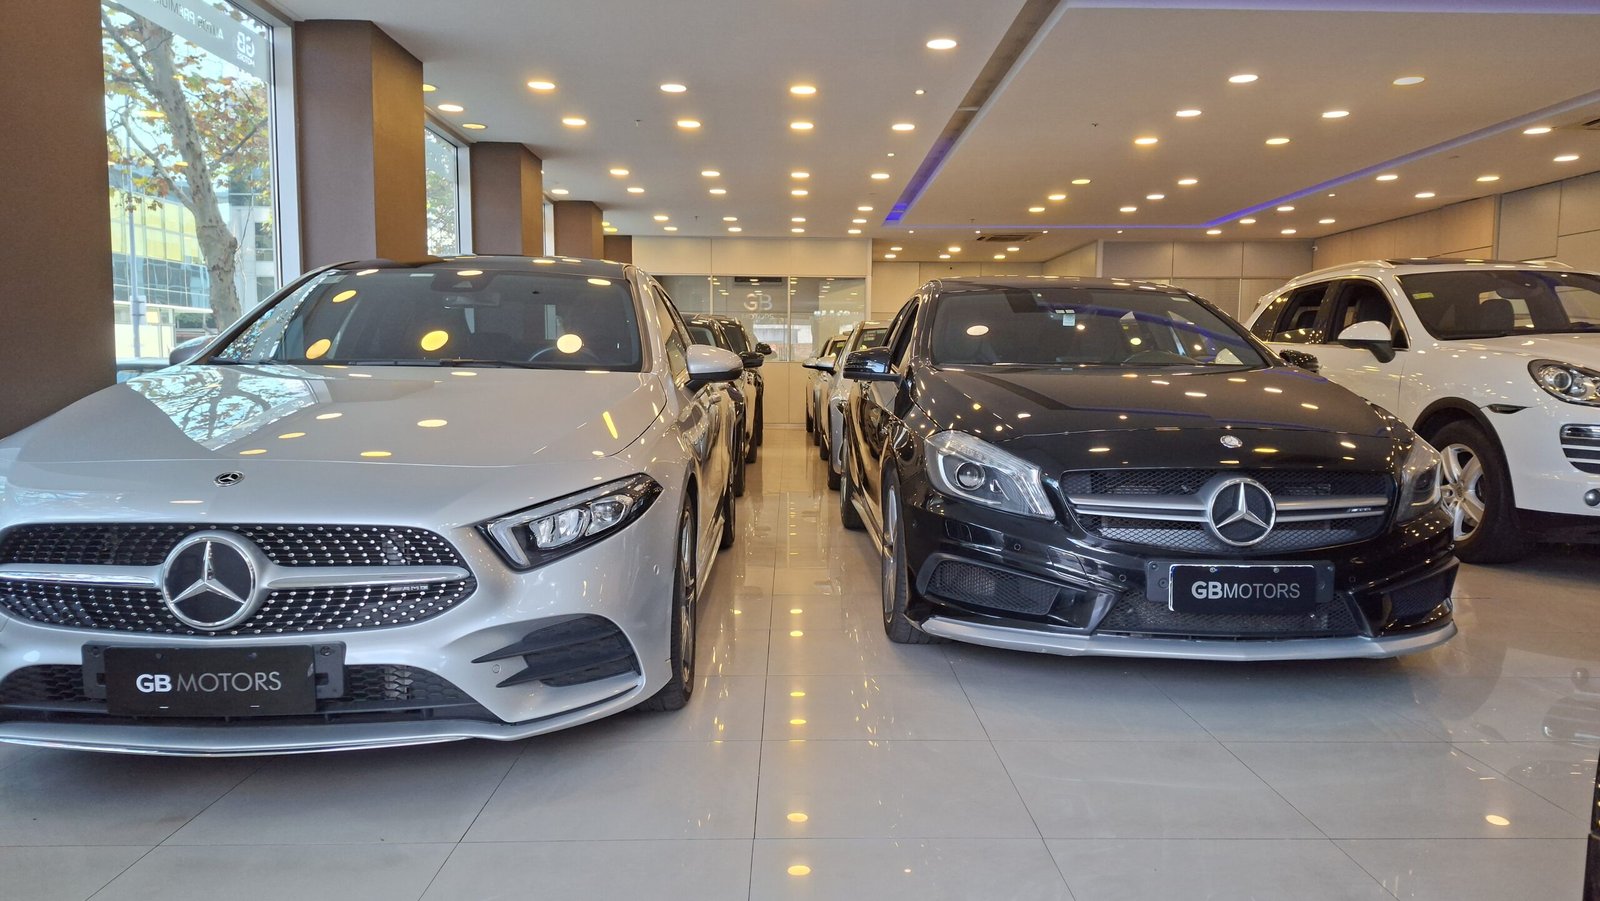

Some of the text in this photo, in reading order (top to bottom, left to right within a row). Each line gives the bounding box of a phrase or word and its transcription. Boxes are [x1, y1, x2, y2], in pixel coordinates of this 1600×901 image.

[743, 293, 773, 311] GB
[136, 671, 282, 693] GB MOTORS
